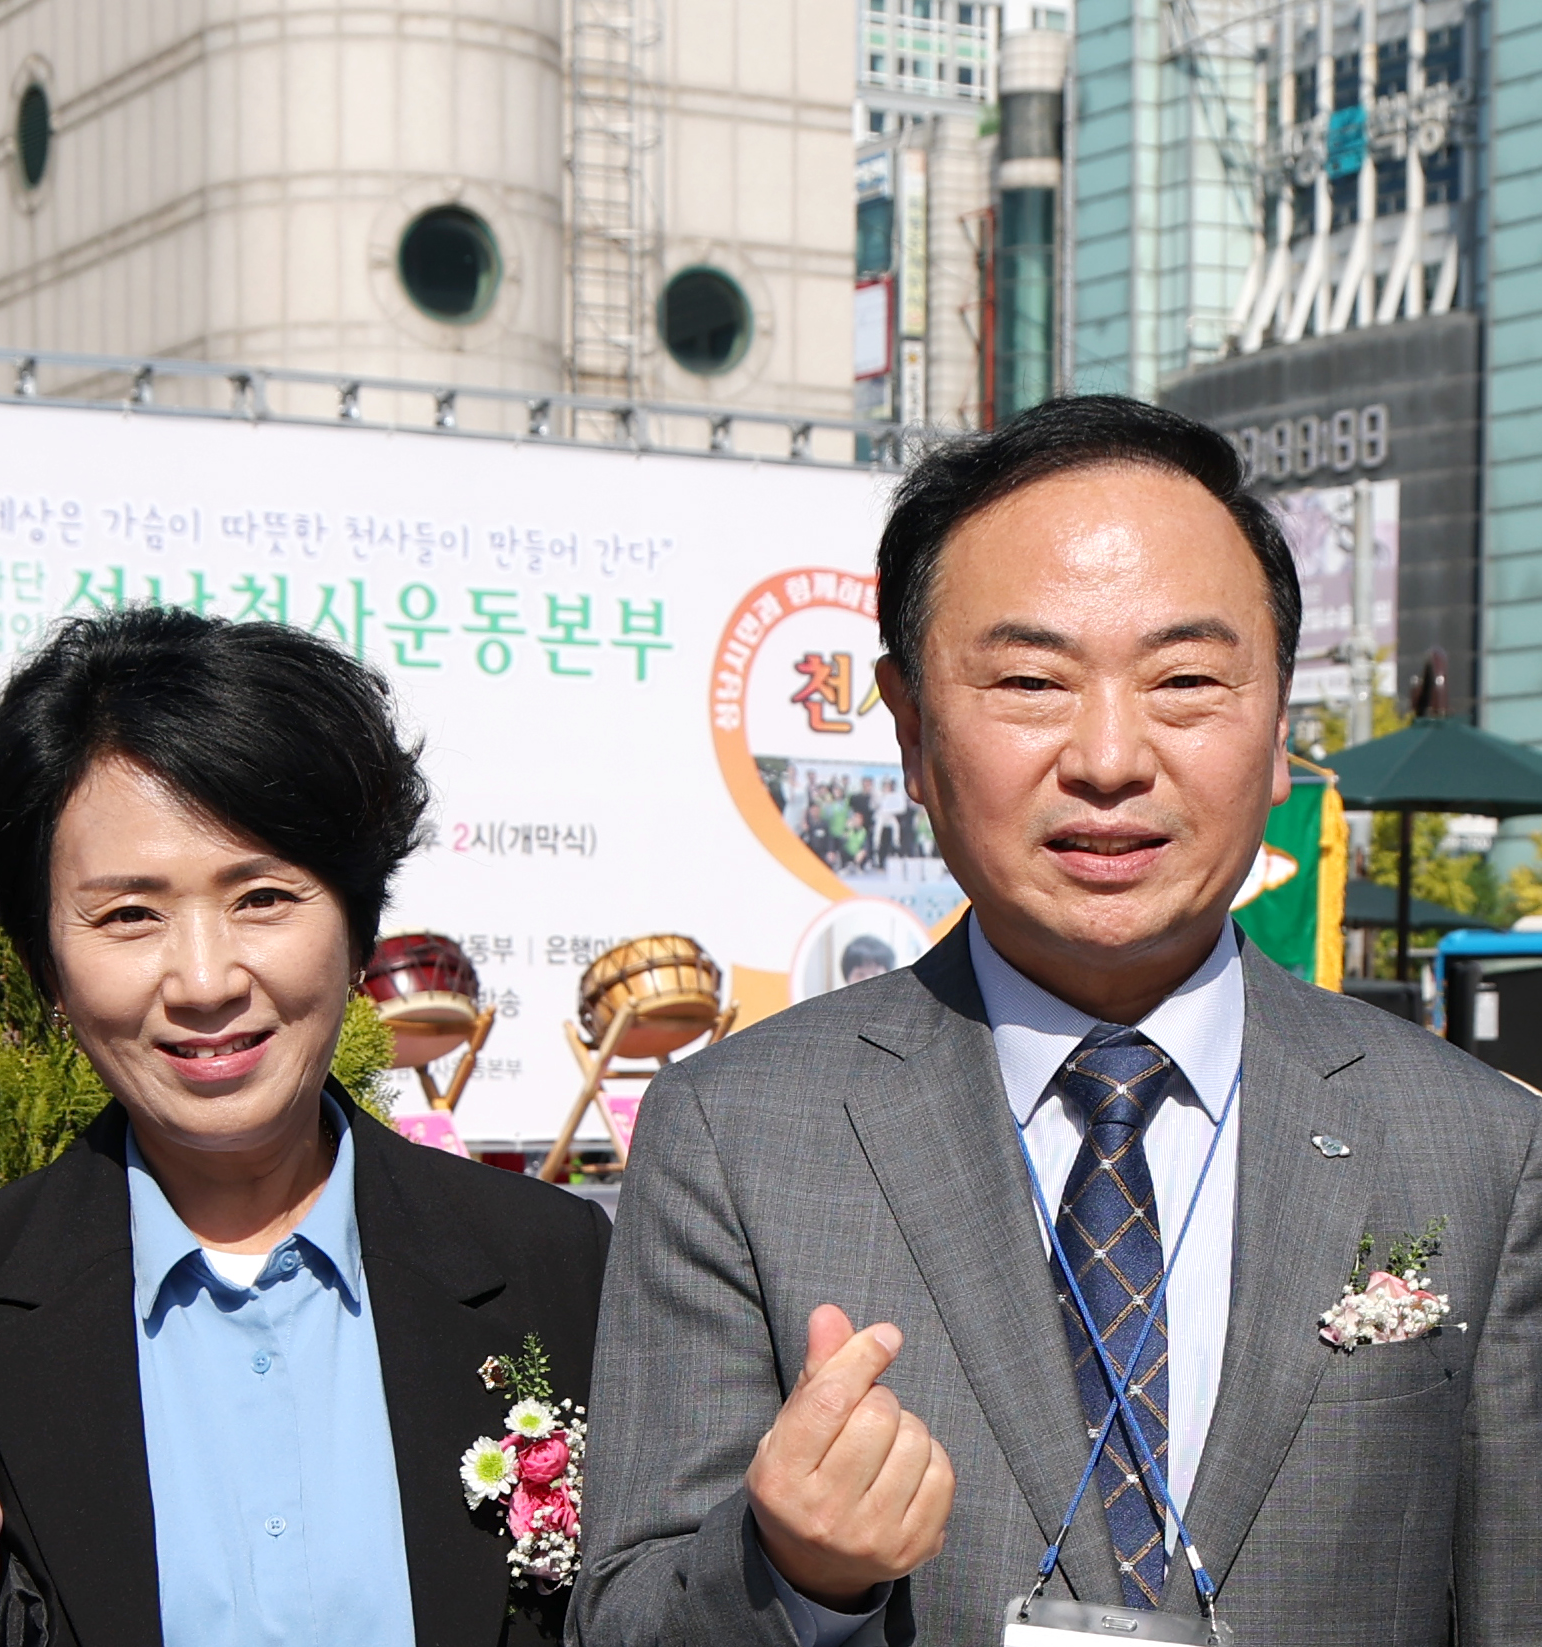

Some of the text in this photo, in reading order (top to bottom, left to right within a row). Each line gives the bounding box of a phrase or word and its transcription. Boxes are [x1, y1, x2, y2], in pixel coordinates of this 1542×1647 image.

[103, 501, 202, 550] 가슴이
[220, 508, 327, 556] 따뜻한
[344, 516, 471, 562] 천사들이
[488, 528, 577, 573] 만들어
[453, 821, 598, 856] 2시(개막식)
